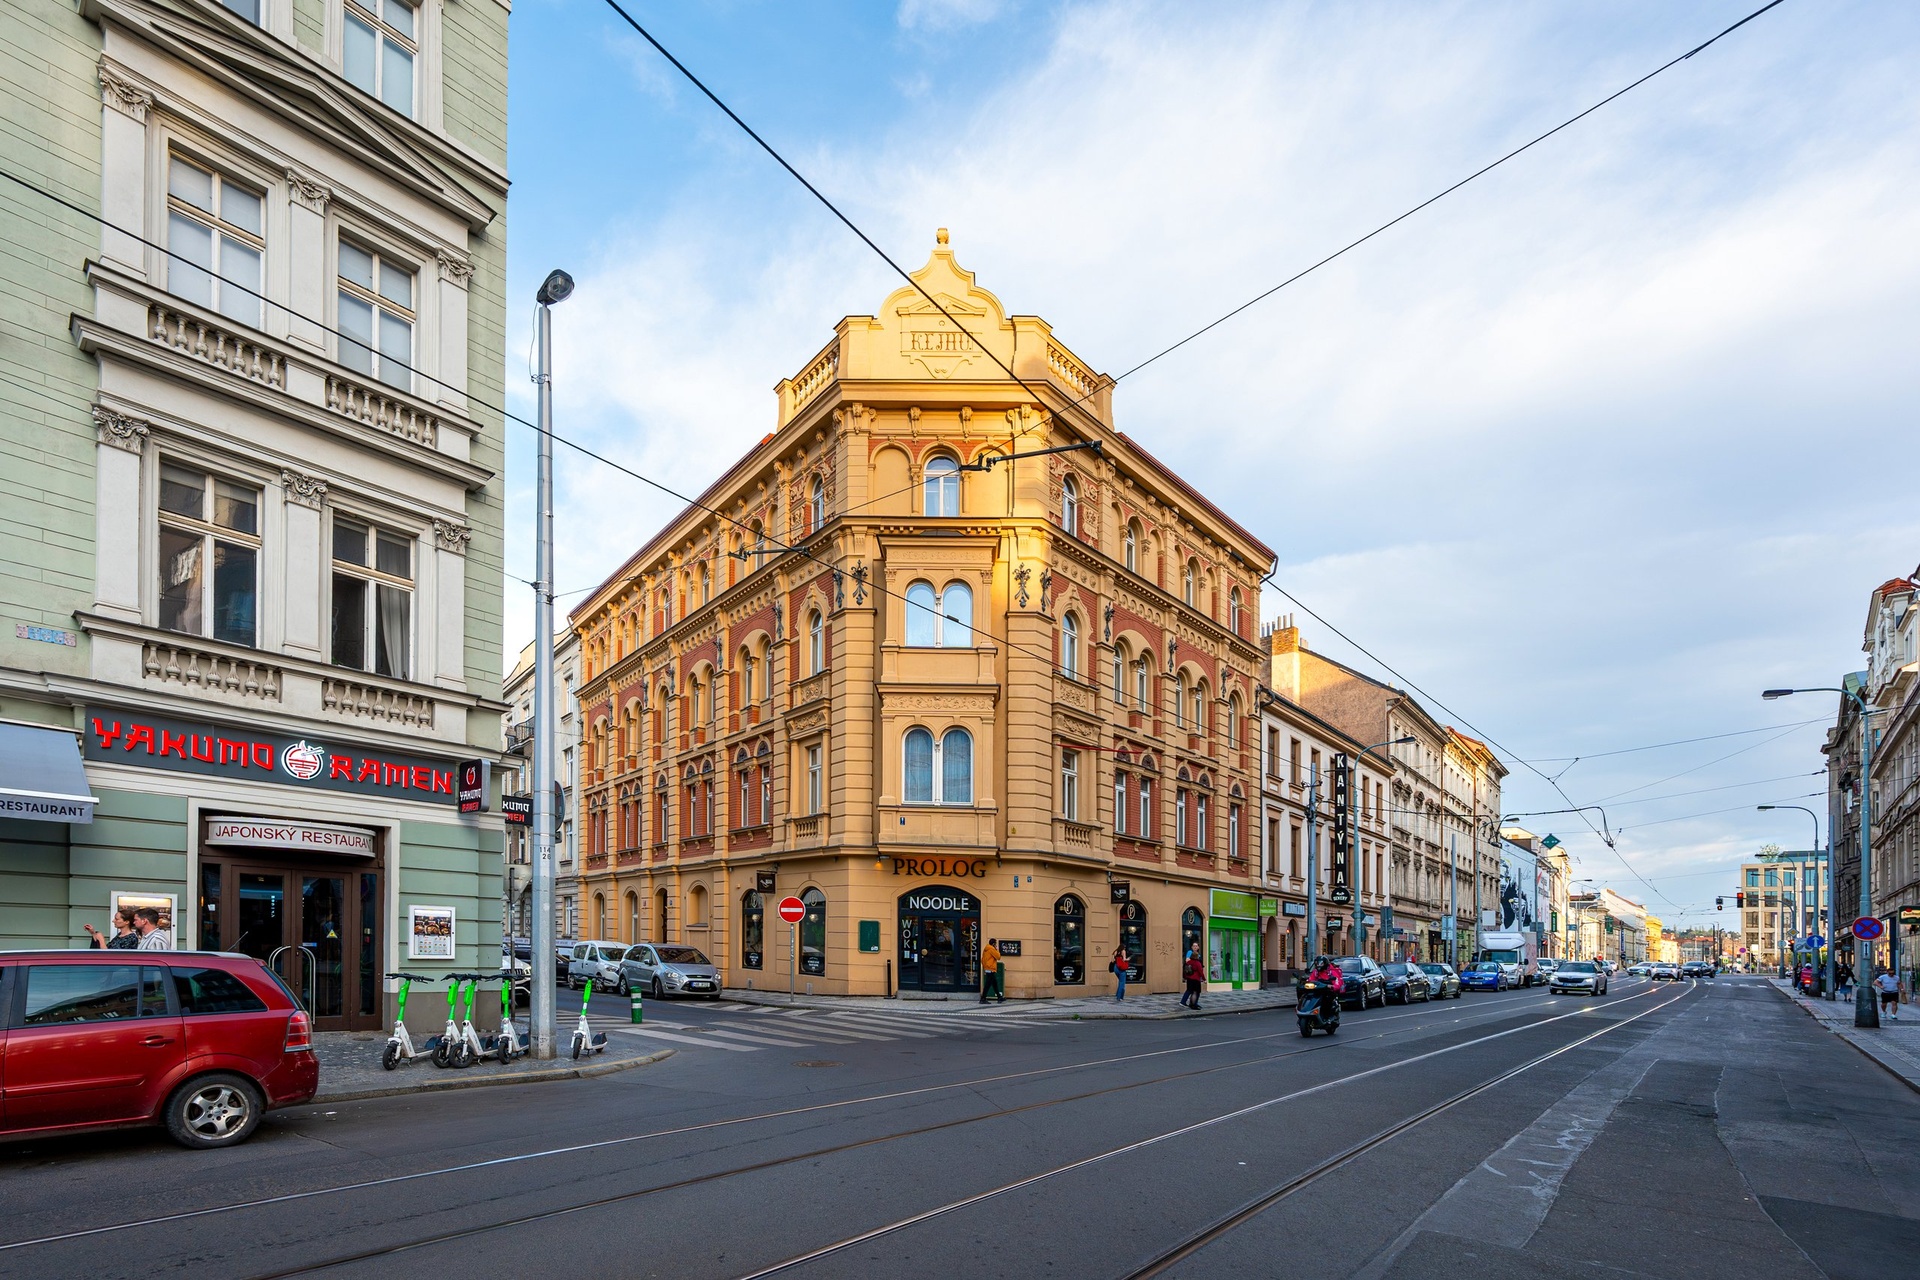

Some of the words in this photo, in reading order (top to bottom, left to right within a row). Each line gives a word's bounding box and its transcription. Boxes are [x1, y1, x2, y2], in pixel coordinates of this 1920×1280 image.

[91, 717, 275, 771] YAKUMO
[329, 754, 453, 795] RAMEN
[0, 799, 85, 817] RESTAURANT
[502, 800, 530, 813] KUMO
[506, 812, 525, 822] MEN
[1336, 755, 1345, 885] KANTÝNA
[215, 825, 297, 841] JAPONSKÝ
[301, 830, 373, 852] RESTAURAN
[892, 858, 987, 878] PROLOG
[909, 896, 969, 911] NOODLE
[902, 919, 912, 949] WOK
[970, 921, 978, 971] SUSHI
